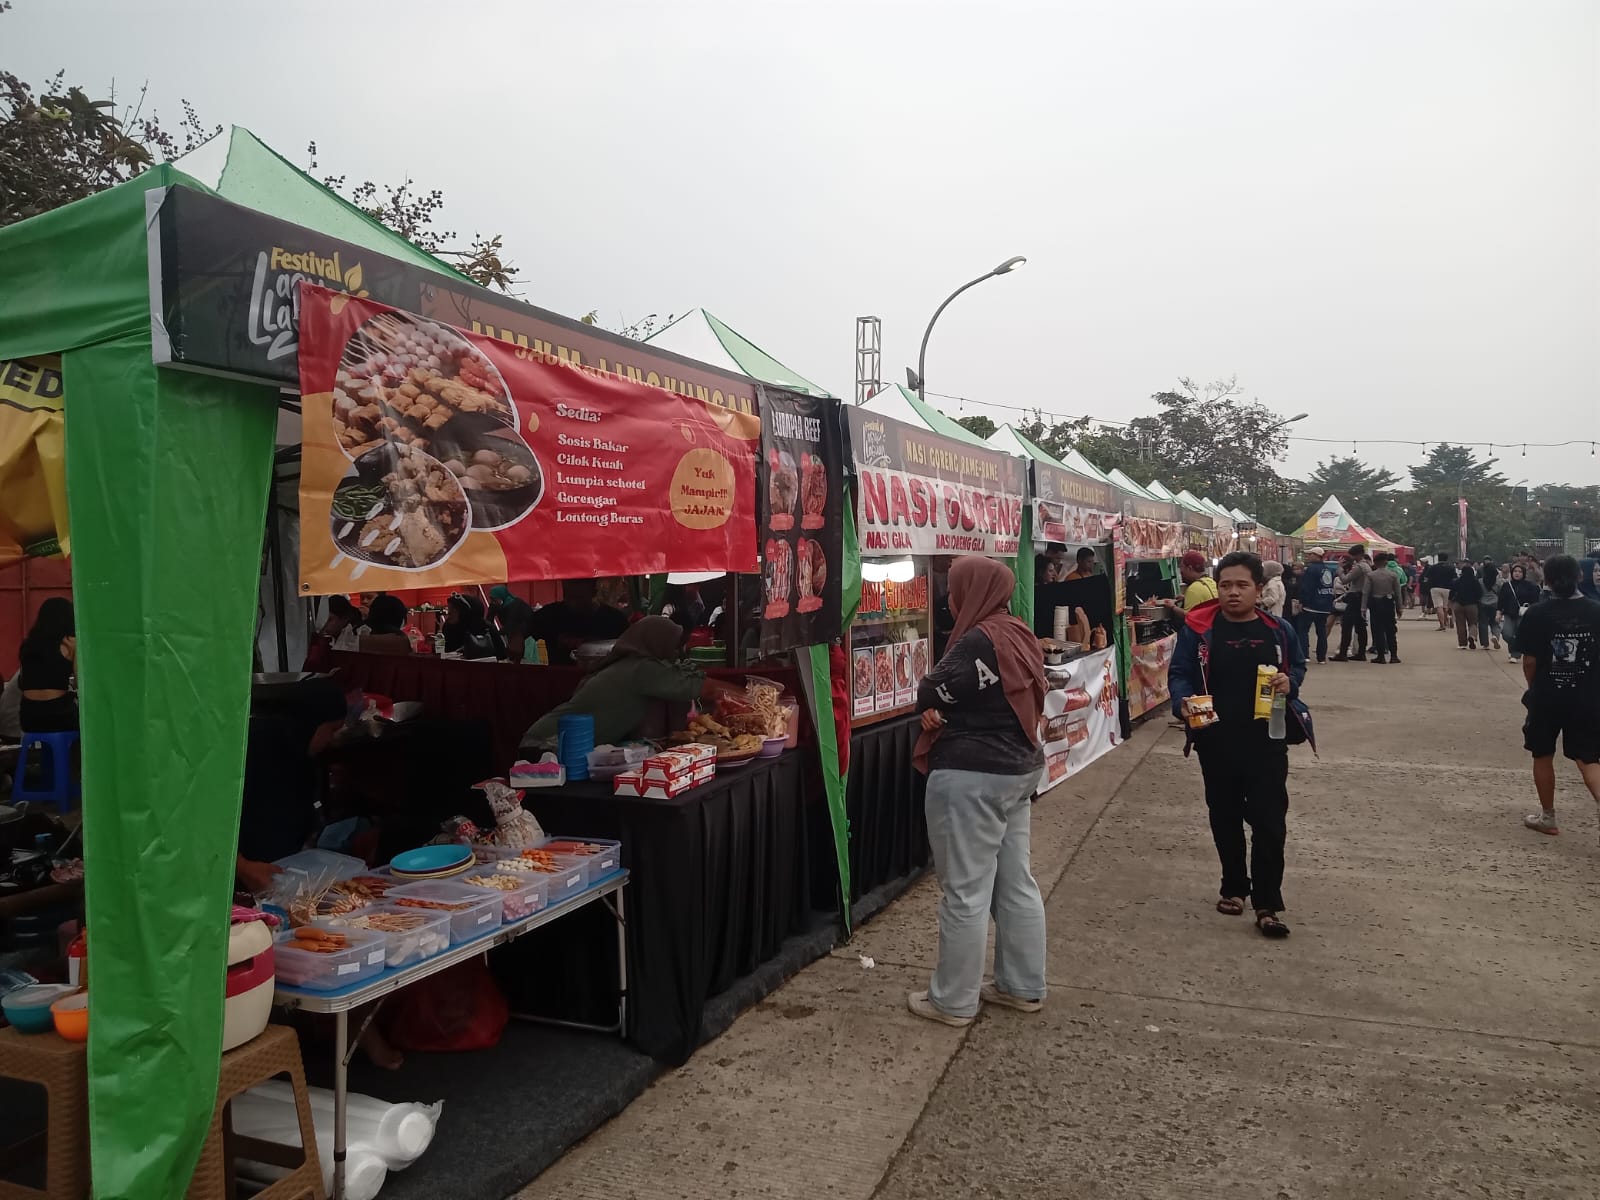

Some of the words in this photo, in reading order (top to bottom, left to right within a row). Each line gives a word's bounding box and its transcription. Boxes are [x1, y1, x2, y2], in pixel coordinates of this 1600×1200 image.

[270, 246, 341, 283] Festival
[0, 362, 64, 398] ED
[556, 403, 601, 423] Sedia:
[804, 416, 821, 443] BEEF
[558, 433, 591, 448] Sosis
[593, 437, 629, 453] Bakar
[557, 453, 590, 466] Cilok
[592, 456, 623, 470] Kuah
[906, 440, 927, 465] NASI
[929, 447, 959, 473] GORENG
[557, 472, 604, 488] Lumpia
[606, 478, 646, 489] schotel
[694, 467, 715, 479] Yuk
[557, 492, 617, 508] Gorengan
[684, 504, 725, 516] JAJAN
[861, 470, 938, 528] NASI
[943, 485, 1023, 538] GORENG
[557, 511, 608, 526] Lontong
[610, 512, 644, 524] Buras
[866, 531, 889, 550] NASI
[892, 531, 912, 550] GILA
[974, 658, 1000, 691] A
